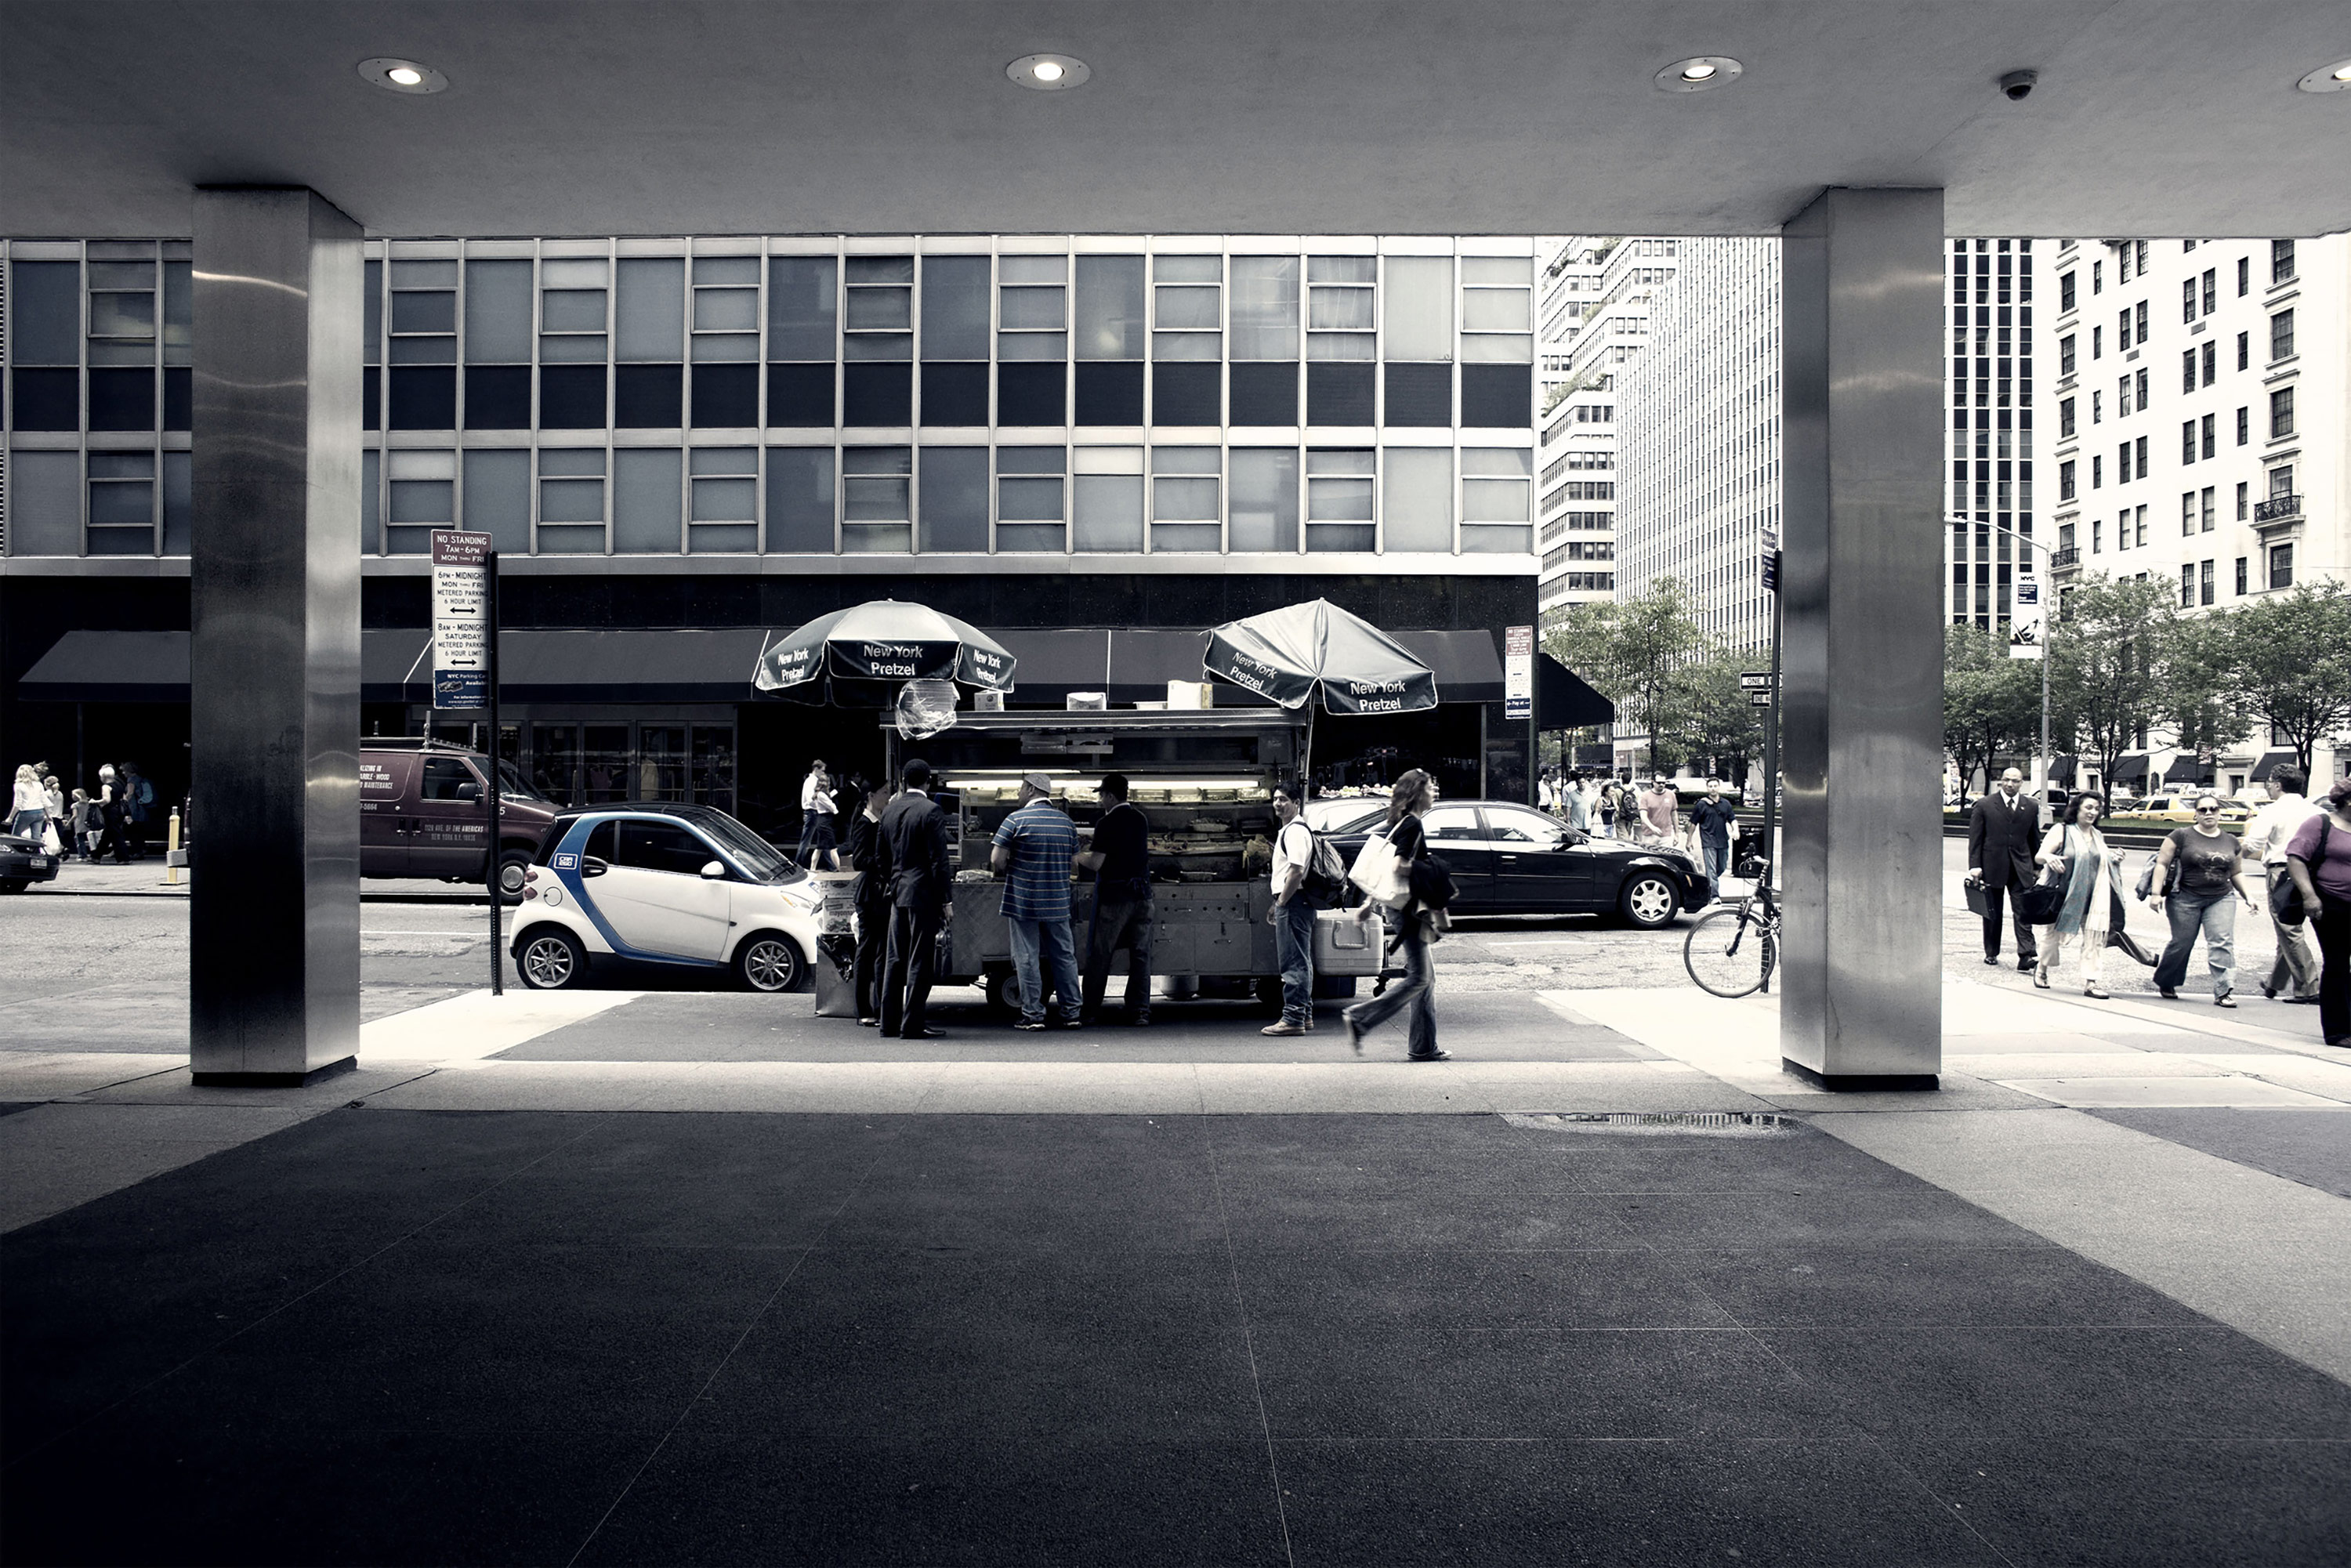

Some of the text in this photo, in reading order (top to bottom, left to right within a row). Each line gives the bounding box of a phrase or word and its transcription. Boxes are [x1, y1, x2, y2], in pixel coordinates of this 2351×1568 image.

[451, 536, 487, 545] STANDING
[777, 649, 809, 665] New York
[864, 645, 923, 658] New York
[973, 650, 1001, 669] New York
[1232, 652, 1278, 679] New York
[781, 666, 805, 681] Pretzel
[871, 663, 915, 675] Pretzel
[976, 668, 997, 684] Pretzel
[1230, 666, 1264, 690] Pretzel
[1350, 682, 1406, 696] New York
[1359, 697, 1401, 712] Pretzel
